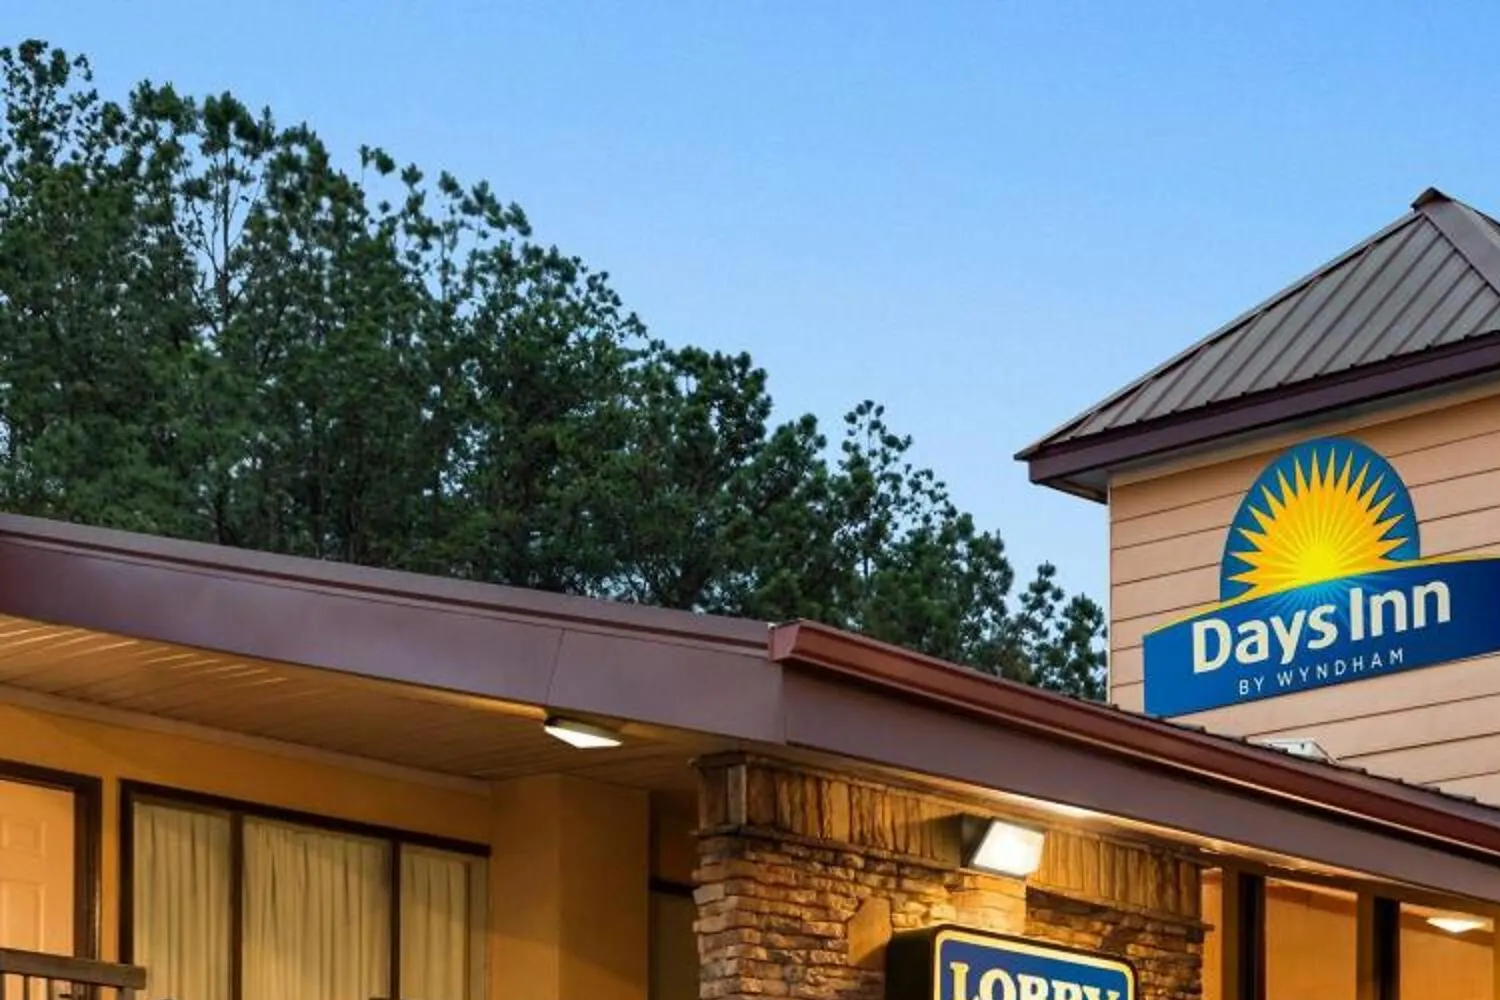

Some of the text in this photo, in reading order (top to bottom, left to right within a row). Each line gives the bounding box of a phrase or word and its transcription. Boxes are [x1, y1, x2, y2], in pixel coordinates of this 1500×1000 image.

[1192, 580, 1451, 673] Days Inn
[1238, 647, 1404, 695] BY WYNDHAM
